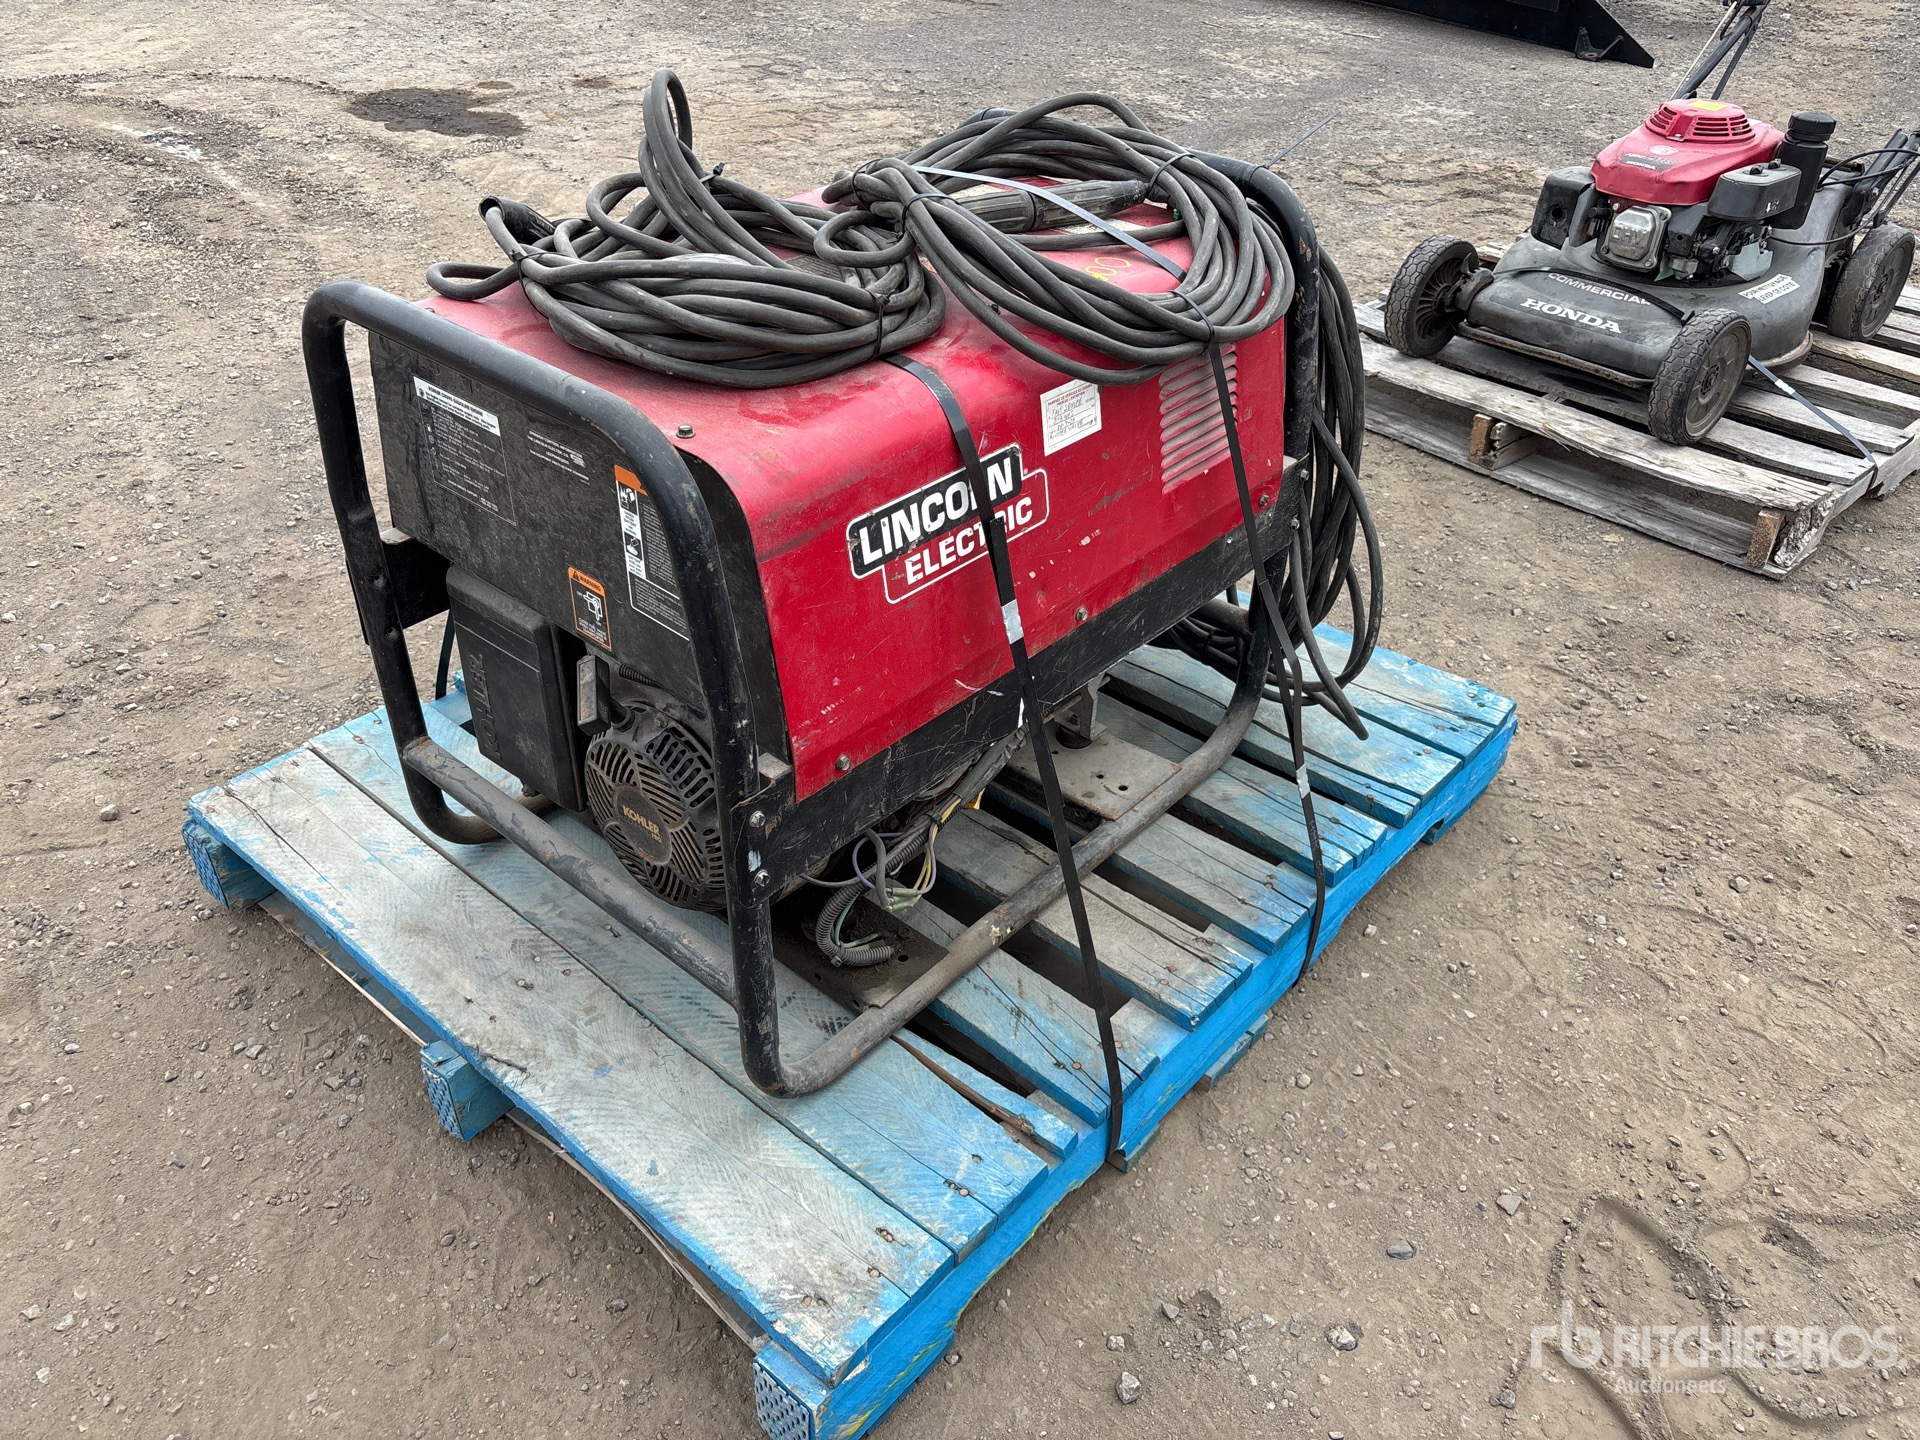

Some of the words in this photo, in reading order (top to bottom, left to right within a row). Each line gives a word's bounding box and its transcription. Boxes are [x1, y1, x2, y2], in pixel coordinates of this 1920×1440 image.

[1547, 272, 1651, 306] COMMERCIAL
[1520, 298, 1622, 334] HONDA
[622, 804, 661, 835] KOHLER
[651, 832, 662, 843] PRO
